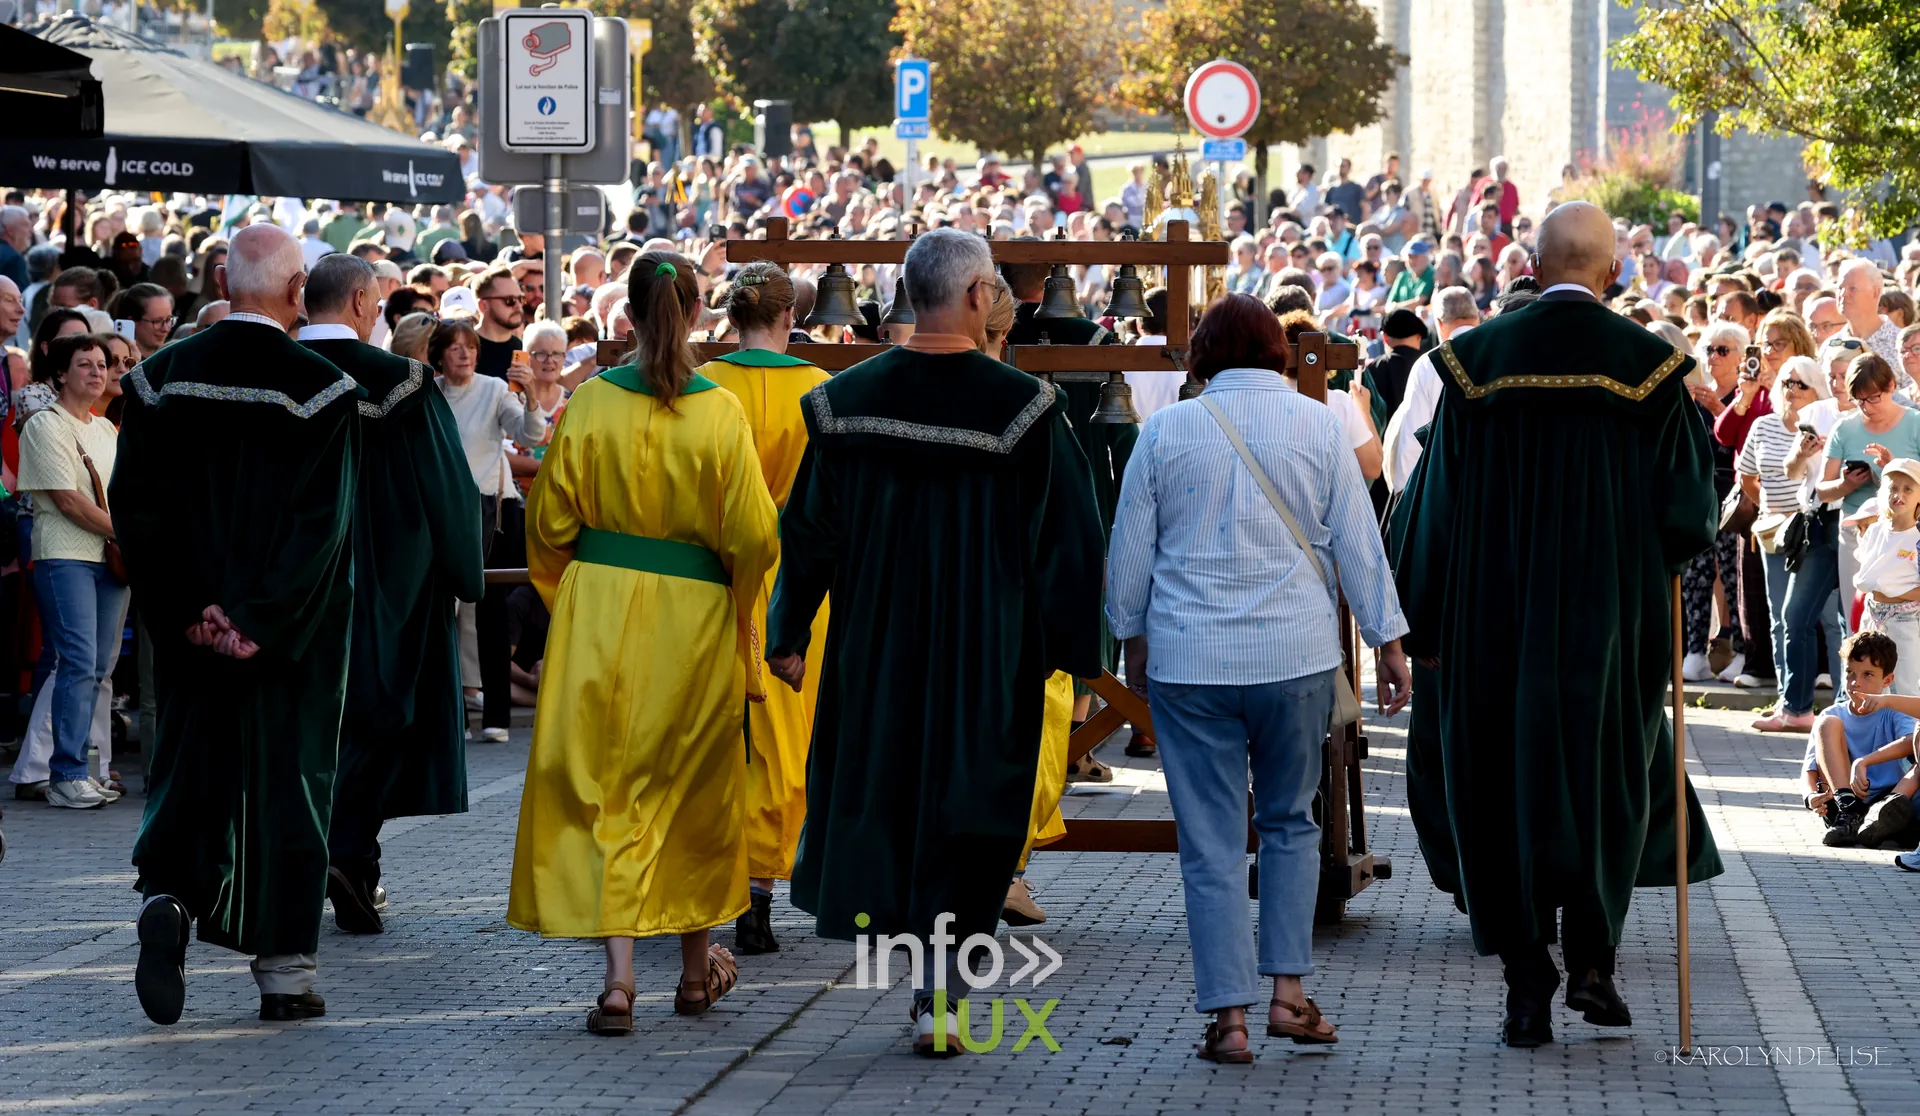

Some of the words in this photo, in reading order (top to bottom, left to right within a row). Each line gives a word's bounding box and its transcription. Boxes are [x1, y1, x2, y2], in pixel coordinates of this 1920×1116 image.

[901, 68, 926, 111] P
[32, 154, 57, 169] We
[60, 158, 101, 172] serve
[121, 160, 147, 174] ICE
[150, 161, 194, 176] COLD
